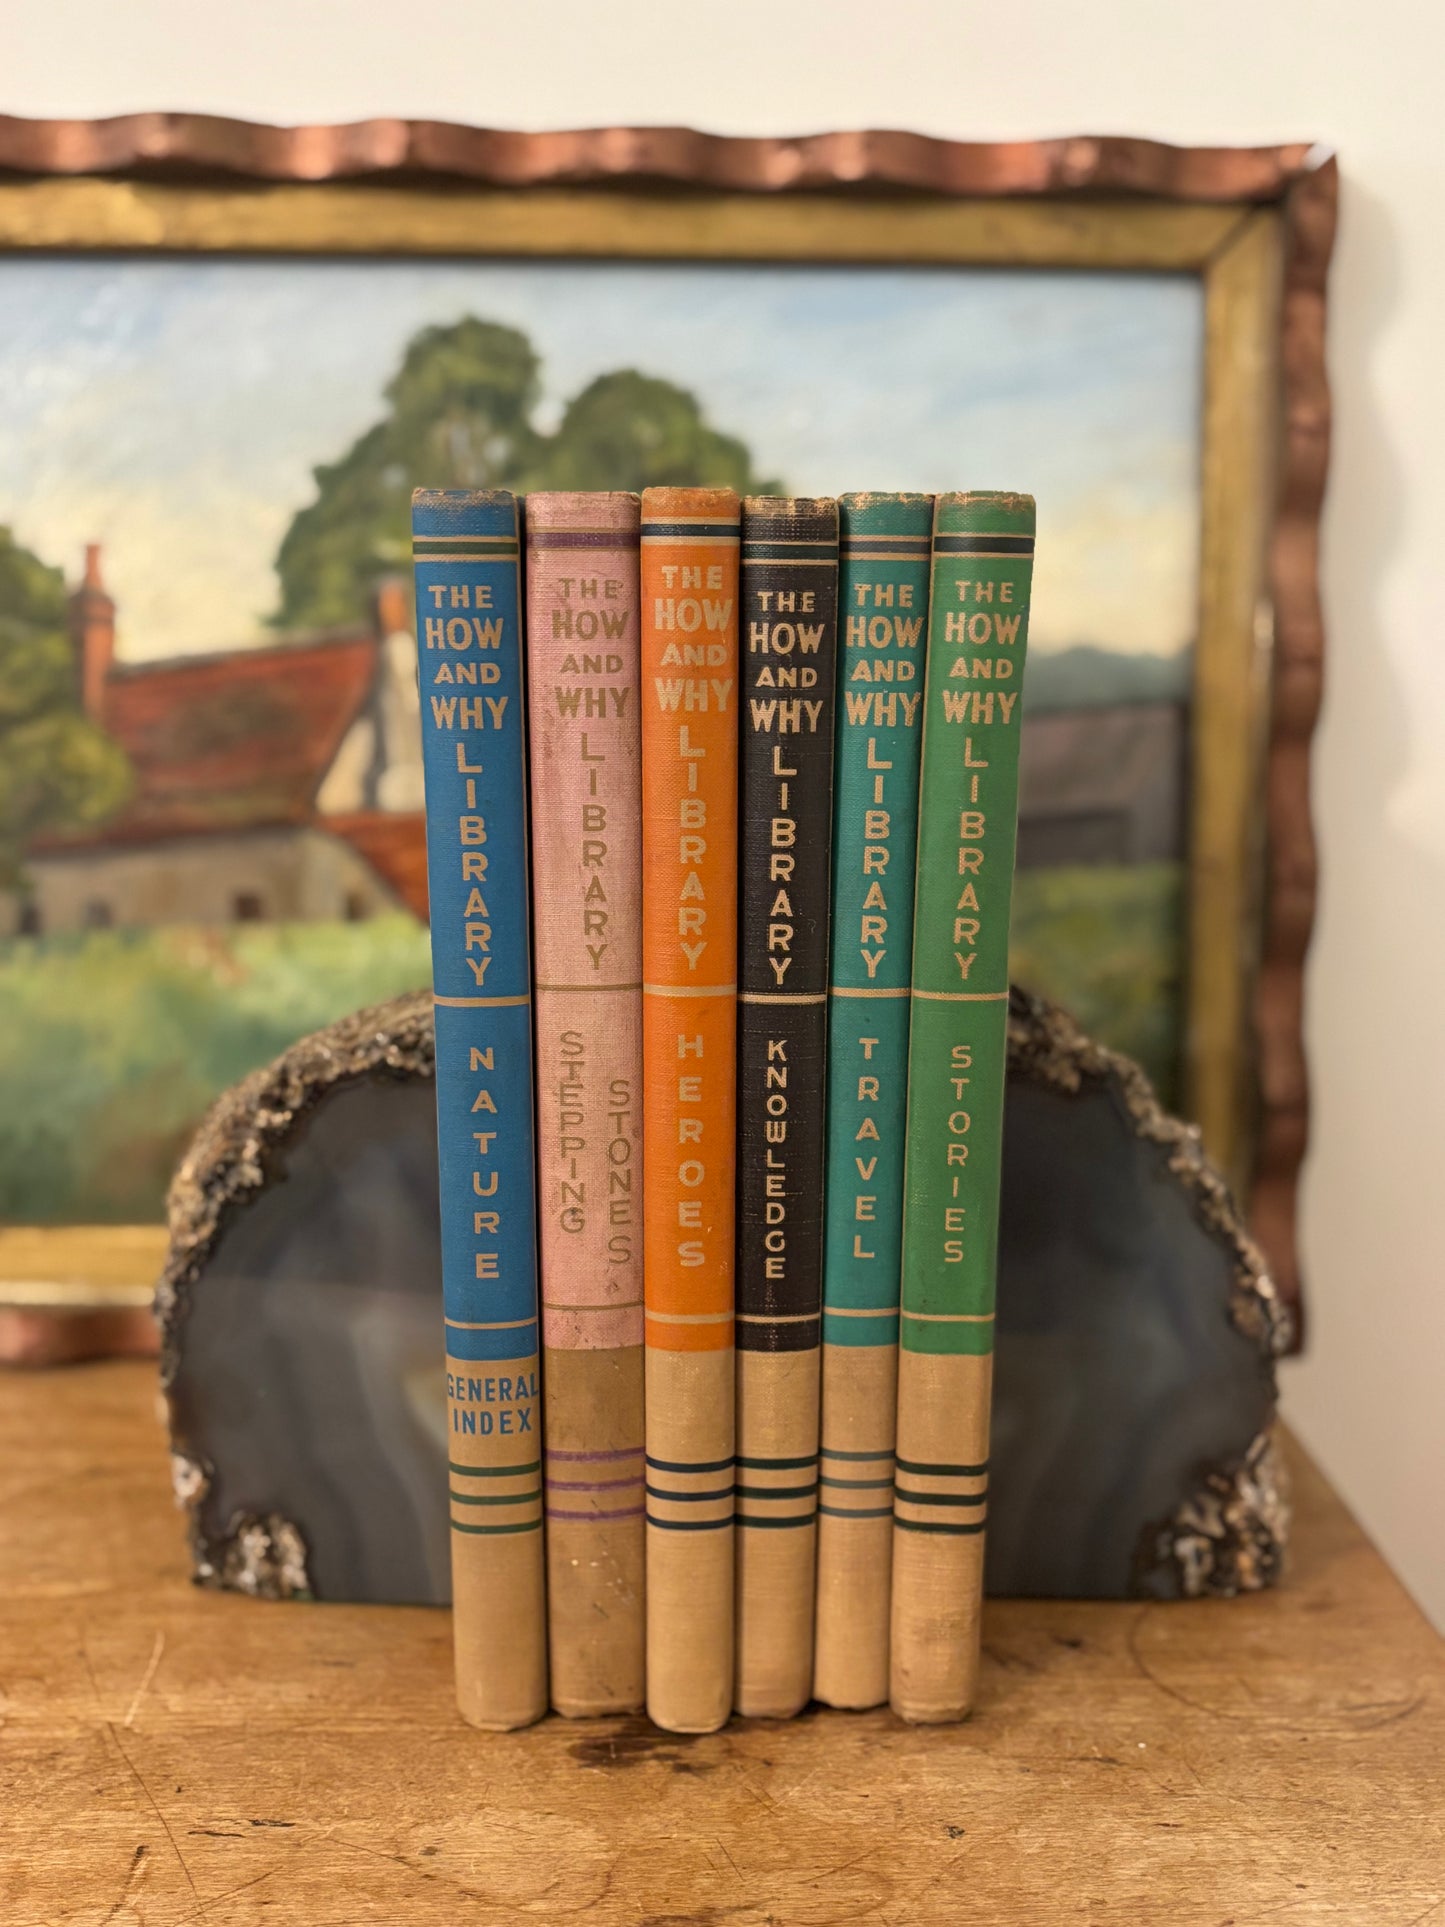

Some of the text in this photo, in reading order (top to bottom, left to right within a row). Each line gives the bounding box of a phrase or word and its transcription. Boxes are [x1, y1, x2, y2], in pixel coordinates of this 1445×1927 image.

[558, 577, 623, 599] THE
[662, 565, 722, 589] THE
[955, 580, 1014, 603] THE
[428, 585, 493, 609] THE
[757, 591, 815, 613] THE
[854, 584, 914, 608] THE
[551, 609, 629, 640] HOW
[654, 598, 733, 632] HOW
[846, 615, 925, 648] HOW
[945, 612, 1021, 645] HOW
[425, 617, 504, 650] HOW
[750, 622, 825, 655] HOW
[559, 654, 623, 674] AND
[660, 643, 727, 666] AND
[851, 660, 915, 682] AND
[949, 657, 1013, 679] AND
[434, 662, 501, 685] AND
[755, 666, 818, 688] AND
[555, 687, 630, 718] WHY
[654, 677, 733, 712] WHY
[844, 691, 921, 727] WHY
[943, 690, 1017, 724] WHY
[431, 696, 508, 730] WHY
[750, 699, 824, 733] WHY
[456, 742, 492, 986] LIBRARY
[581, 732, 608, 970] LIBRARY
[678, 725, 707, 970] LIBRARY
[860, 737, 893, 978] LIBRARY
[953, 737, 989, 979] LIBRARY
[768, 745, 798, 985] LIBRARY
[560, 1030, 585, 1234] STEPPING
[853, 1037, 880, 1258] TRAVEL
[469, 1047, 500, 1279] NATURE
[677, 1034, 705, 1268] HEROES
[765, 1040, 787, 1279] KNOWLEDGE
[944, 1045, 972, 1263] STORIES
[608, 1079, 631, 1265] STONES
[447, 1372, 538, 1402] GENERAL
[453, 1407, 531, 1435] INDEX
